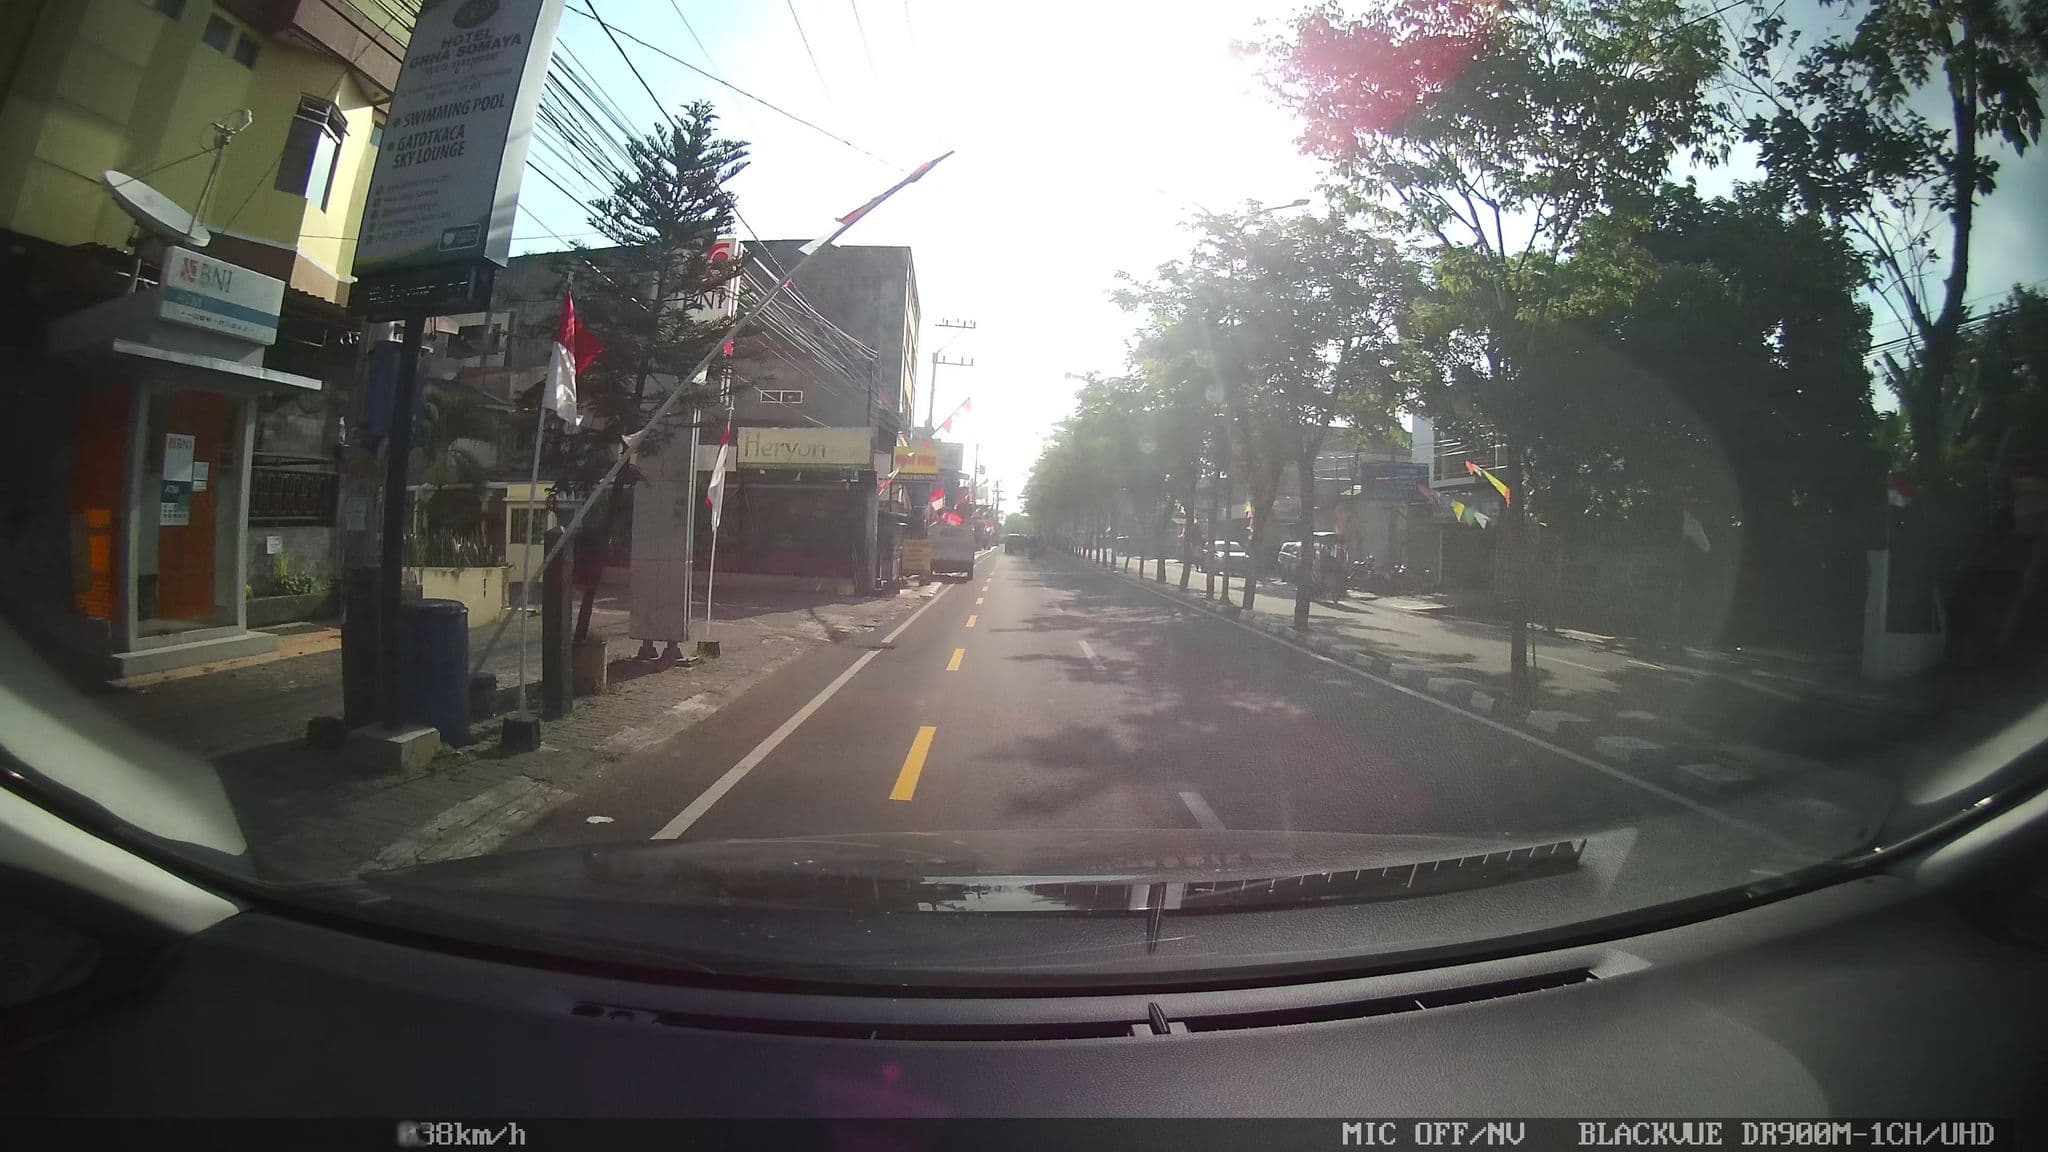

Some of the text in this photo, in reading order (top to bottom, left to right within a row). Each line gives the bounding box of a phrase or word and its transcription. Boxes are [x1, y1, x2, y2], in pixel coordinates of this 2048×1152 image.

[441, 28, 494, 50] HOTEL
[456, 32, 522, 57] SOMAYA
[403, 92, 505, 128] SWIMMING POOL
[397, 123, 465, 152] GATOTKACA
[393, 140, 465, 169] SKY LOUNGE
[200, 262, 233, 294] BNI
